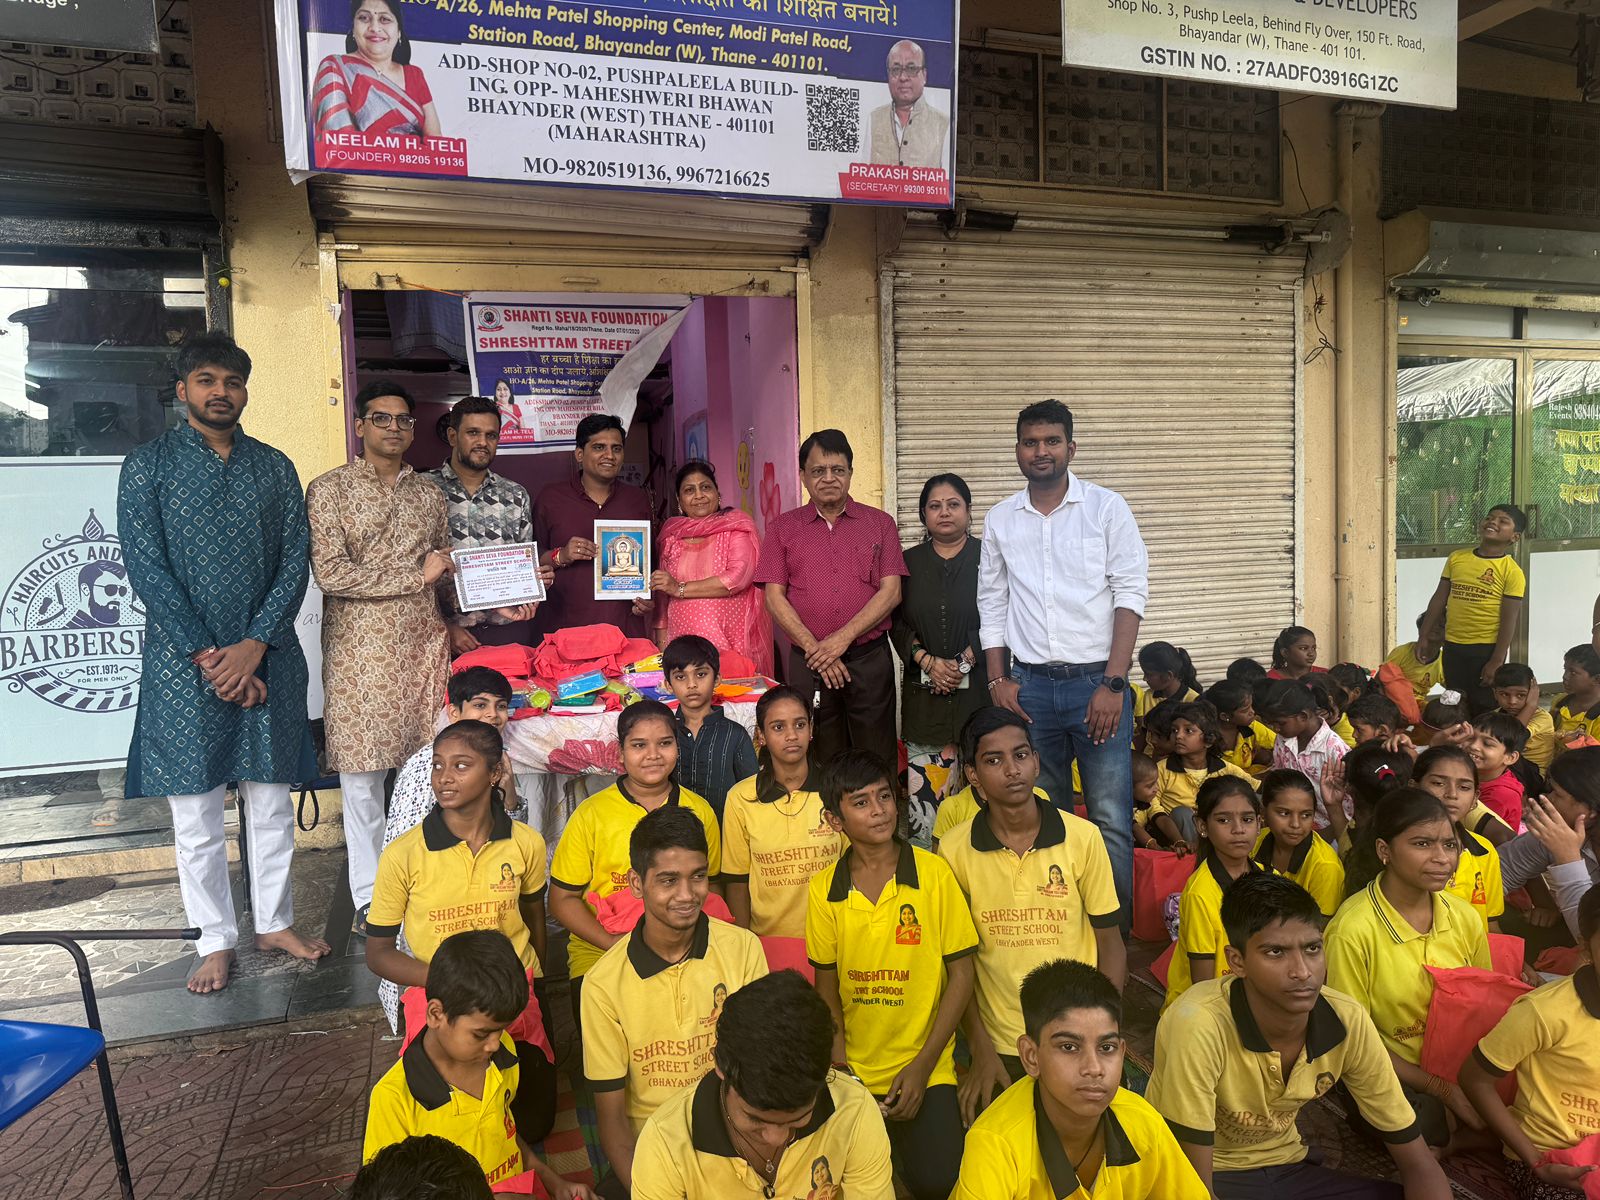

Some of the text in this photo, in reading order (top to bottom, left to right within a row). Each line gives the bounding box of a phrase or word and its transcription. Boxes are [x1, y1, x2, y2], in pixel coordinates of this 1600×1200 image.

[488, 0, 542, 20] Mehta
[547, 6, 588, 26] Patel
[593, 12, 667, 36] Shopping
[673, 18, 724, 40] Center,
[729, 24, 768, 42] Modi
[771, 30, 808, 48] Patel
[812, 33, 852, 52] Road,
[1108, 0, 1425, 53] Shop No. 3, Pushp Leela, Behind Fly Over, 150 Ft. Road,
[468, 24, 527, 44] Station
[532, 29, 579, 51] Road,
[584, 35, 671, 59] Bhayandar
[676, 42, 704, 64] (W),
[711, 46, 756, 65] Thane
[772, 54, 828, 73] 401101.
[1179, 24, 1242, 44] Bhayandar
[1246, 33, 1270, 50] (W),
[1274, 36, 1308, 53] Thane
[1320, 43, 1338, 57] 401
[1344, 46, 1366, 61] 101.
[1140, 46, 1195, 68] GSTIN
[1201, 54, 1230, 72] NO.
[438, 53, 799, 97] ADD-SHOP NO-02, PUSHPALEELA BUILD-
[468, 76, 774, 114] ING. OPP- MAHESHWERI BHAWAN
[467, 98, 574, 120] BHAYNDER
[580, 106, 646, 128] (WEST)
[650, 111, 712, 130] THANE
[726, 118, 775, 135] 401101
[325, 133, 464, 154] NEELAM H. TELI
[548, 124, 706, 152] (MAHARASHTRA)
[325, 150, 464, 168] (FOUNDER) 98205 19136
[523, 156, 770, 188] MO-9820519136, 9967216625
[852, 166, 944, 182] PRAKASH SHAH
[846, 181, 947, 196] (SECRETARY) 99300 95111
[504, 309, 552, 323] SHANTI
[555, 310, 588, 324] SEVA
[591, 311, 668, 326] FOUNDATION
[480, 336, 632, 351] SHRESHTTAM STREET
[1548, 412, 1572, 420] Events
[12, 546, 122, 604] HAIRCUTS AND
[86, 664, 118, 676] EST.1973
[753, 842, 838, 864] SHRESHTTAM
[760, 864, 796, 877] STREET
[428, 898, 516, 922] SHRESHTTAM
[981, 908, 1068, 924] SHRESHTTAM
[434, 912, 507, 934] STREET SCHOOL
[989, 924, 1064, 936] STREET SCHOOL
[1036, 938, 1059, 946] WEST)
[872, 986, 904, 996] SCHOOL
[642, 1060, 690, 1076] STREET
